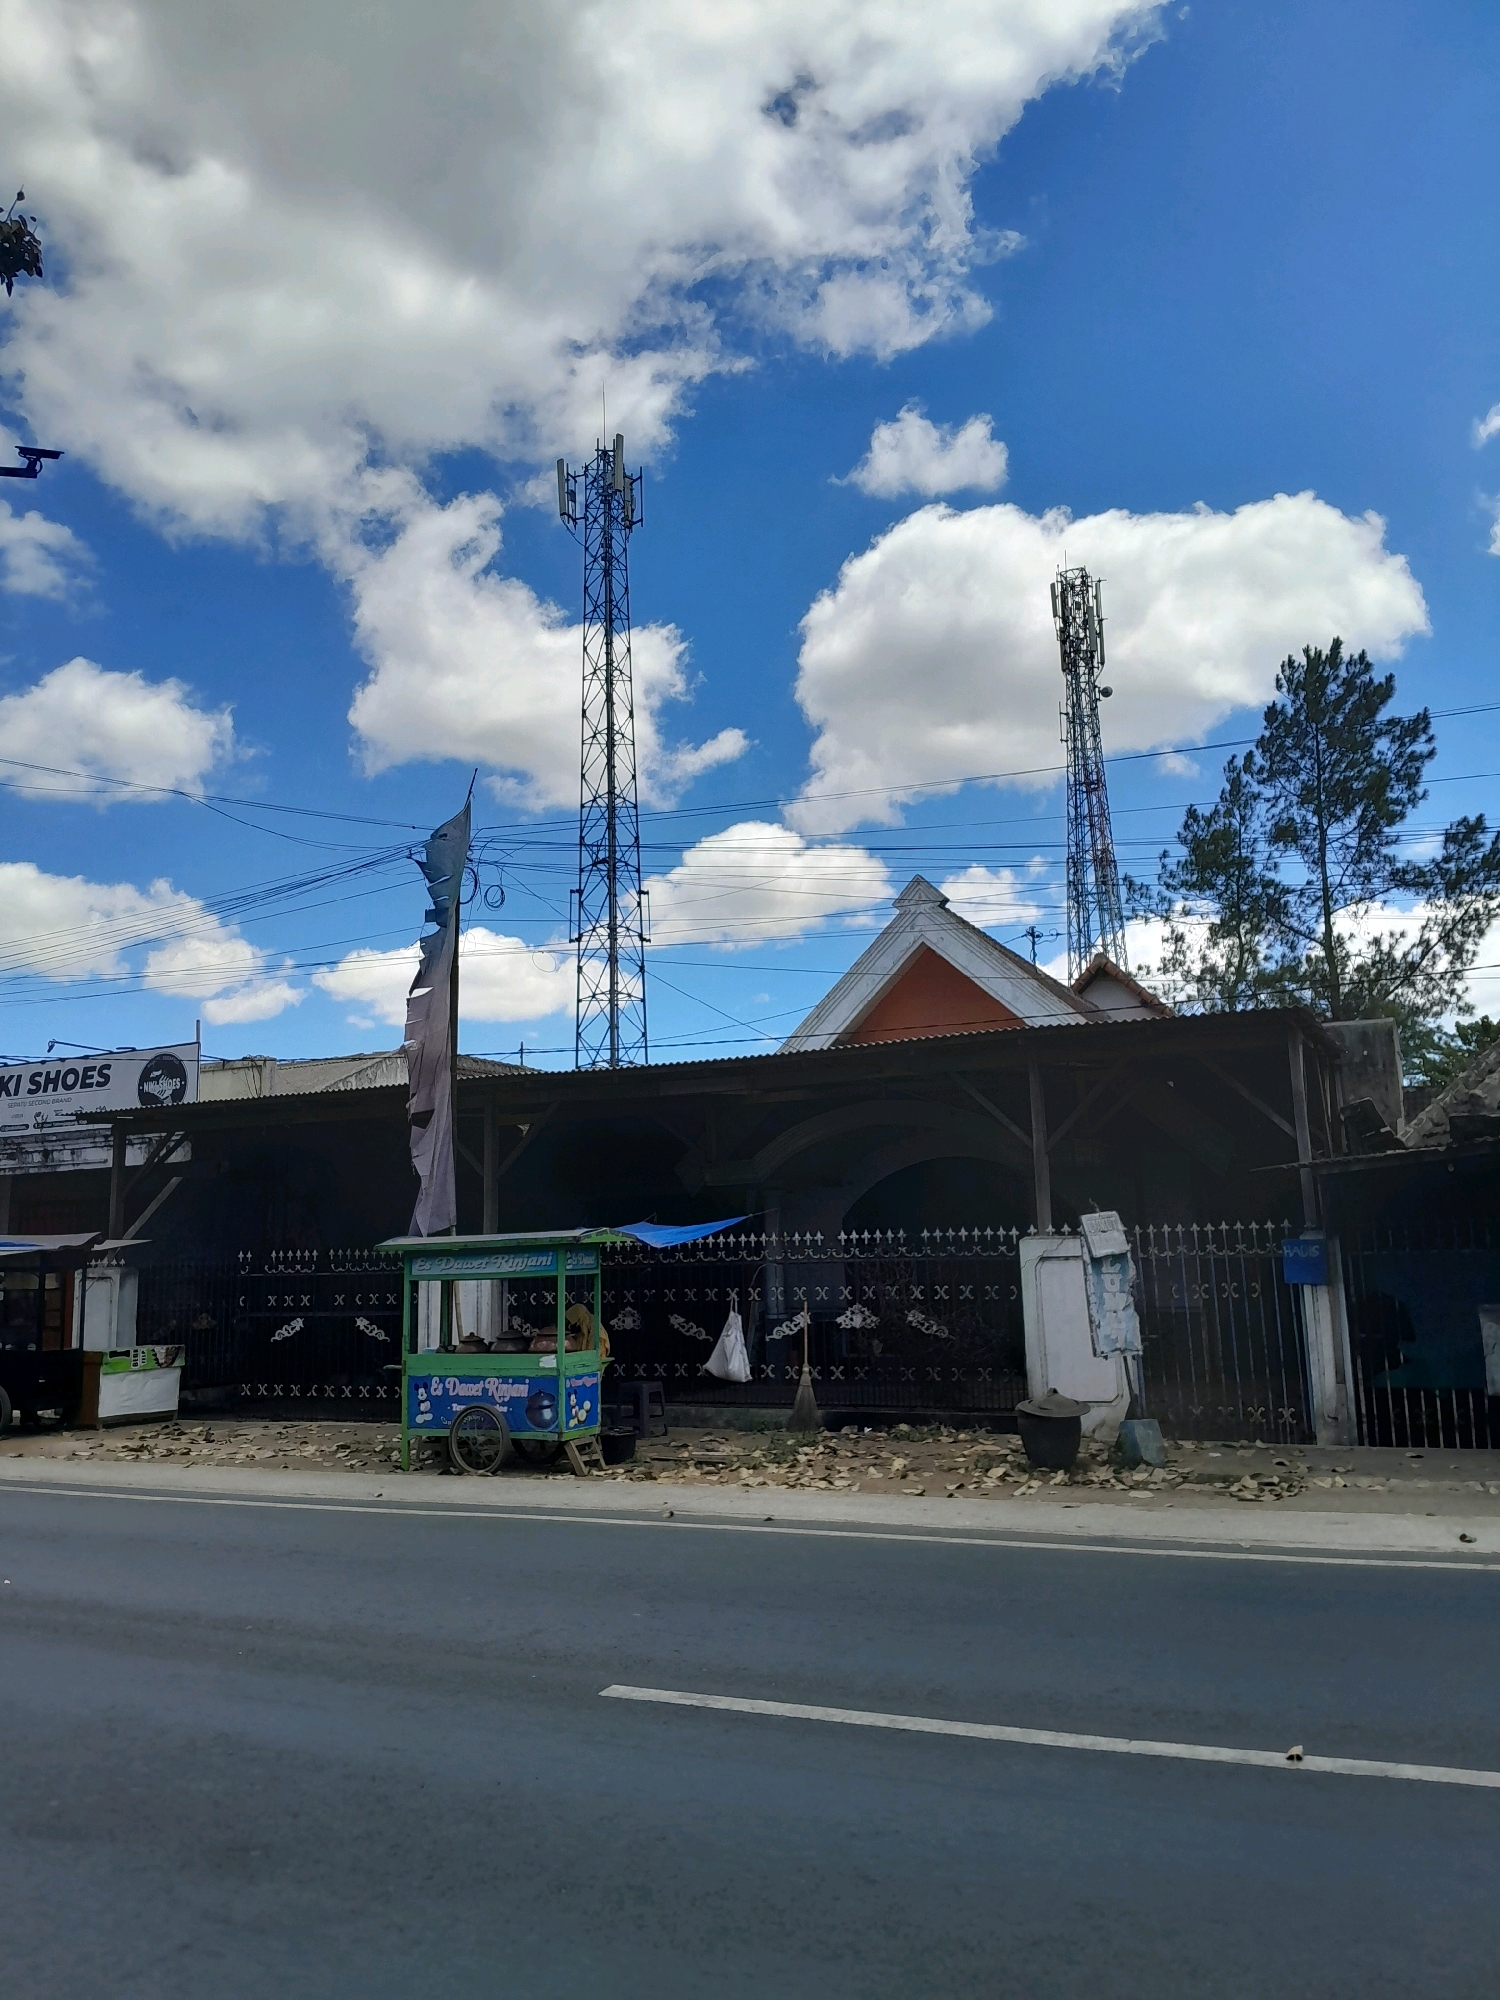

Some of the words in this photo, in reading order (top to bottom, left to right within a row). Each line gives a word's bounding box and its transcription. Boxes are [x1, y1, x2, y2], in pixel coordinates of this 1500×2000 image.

[27, 1063, 112, 1095] SHOES
[28, 1099, 50, 1107] SECOND
[51, 1097, 73, 1105] BRAND
[416, 1257, 432, 1271] Es
[435, 1255, 488, 1272] Dawet
[490, 1252, 553, 1272] Rinjani
[430, 1376, 443, 1396] Es
[444, 1377, 484, 1397] Dawet
[484, 1377, 530, 1403] Rinjani
